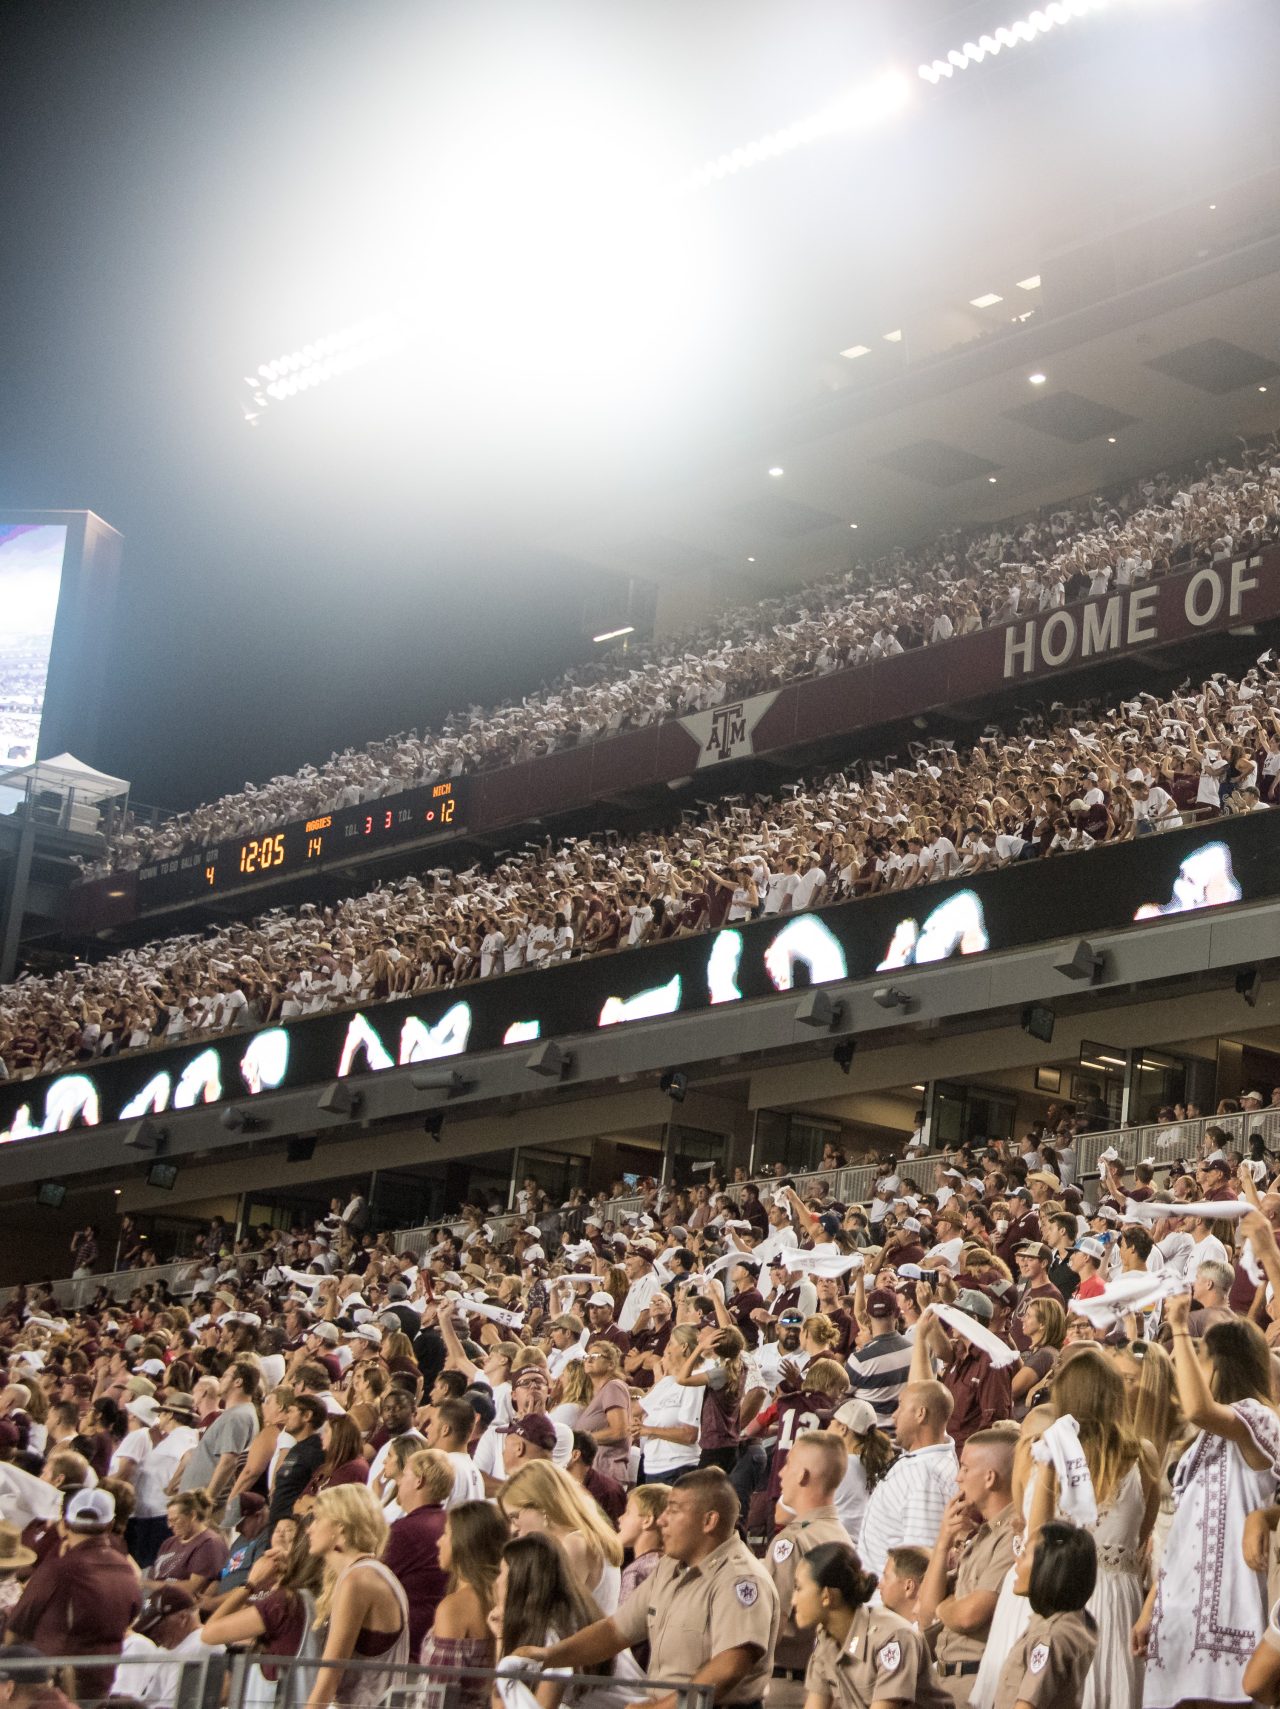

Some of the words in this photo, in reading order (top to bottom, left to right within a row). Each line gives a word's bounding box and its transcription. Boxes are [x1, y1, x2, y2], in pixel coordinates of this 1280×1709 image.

[1004, 586, 1160, 679] HOME
[1185, 555, 1264, 626] OF
[384, 810, 393, 829] 3
[441, 799, 455, 823] 12
[306, 815, 332, 832] AGGIES
[364, 816, 373, 835] 3
[240, 834, 285, 873] 12:05
[308, 836, 322, 859] 14
[206, 866, 215, 885] 4
